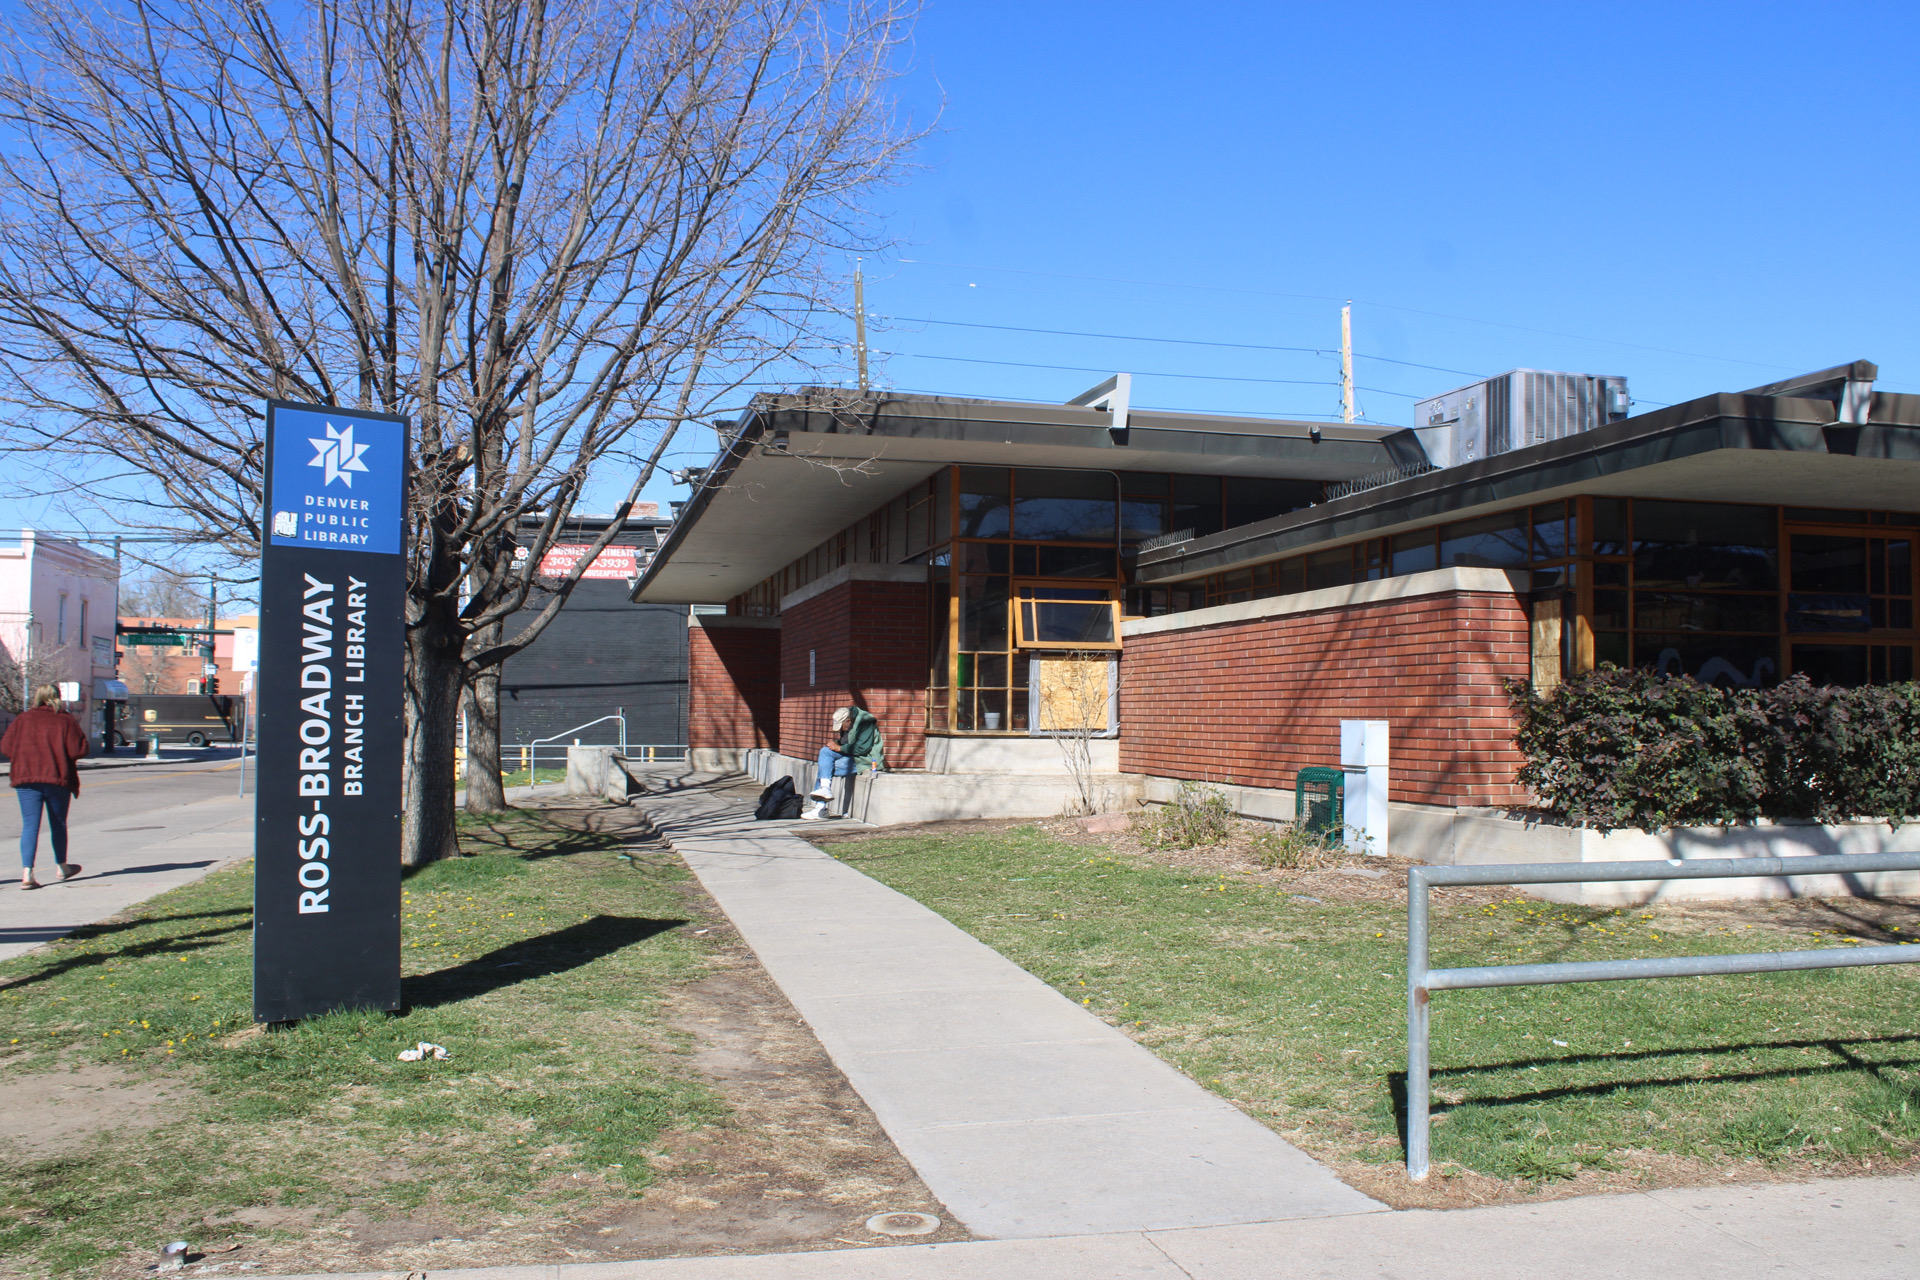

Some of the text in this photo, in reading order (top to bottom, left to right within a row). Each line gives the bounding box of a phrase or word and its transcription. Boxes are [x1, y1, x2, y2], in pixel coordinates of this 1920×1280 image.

[305, 495, 369, 511] DENVER
[304, 513, 369, 528] PUBLIC
[304, 530, 369, 545] LIBRARY
[547, 546, 586, 556] ENOVATED
[344, 575, 367, 796] BRANCH LIBRARY
[299, 572, 335, 914] ROSS-BROADWAY
